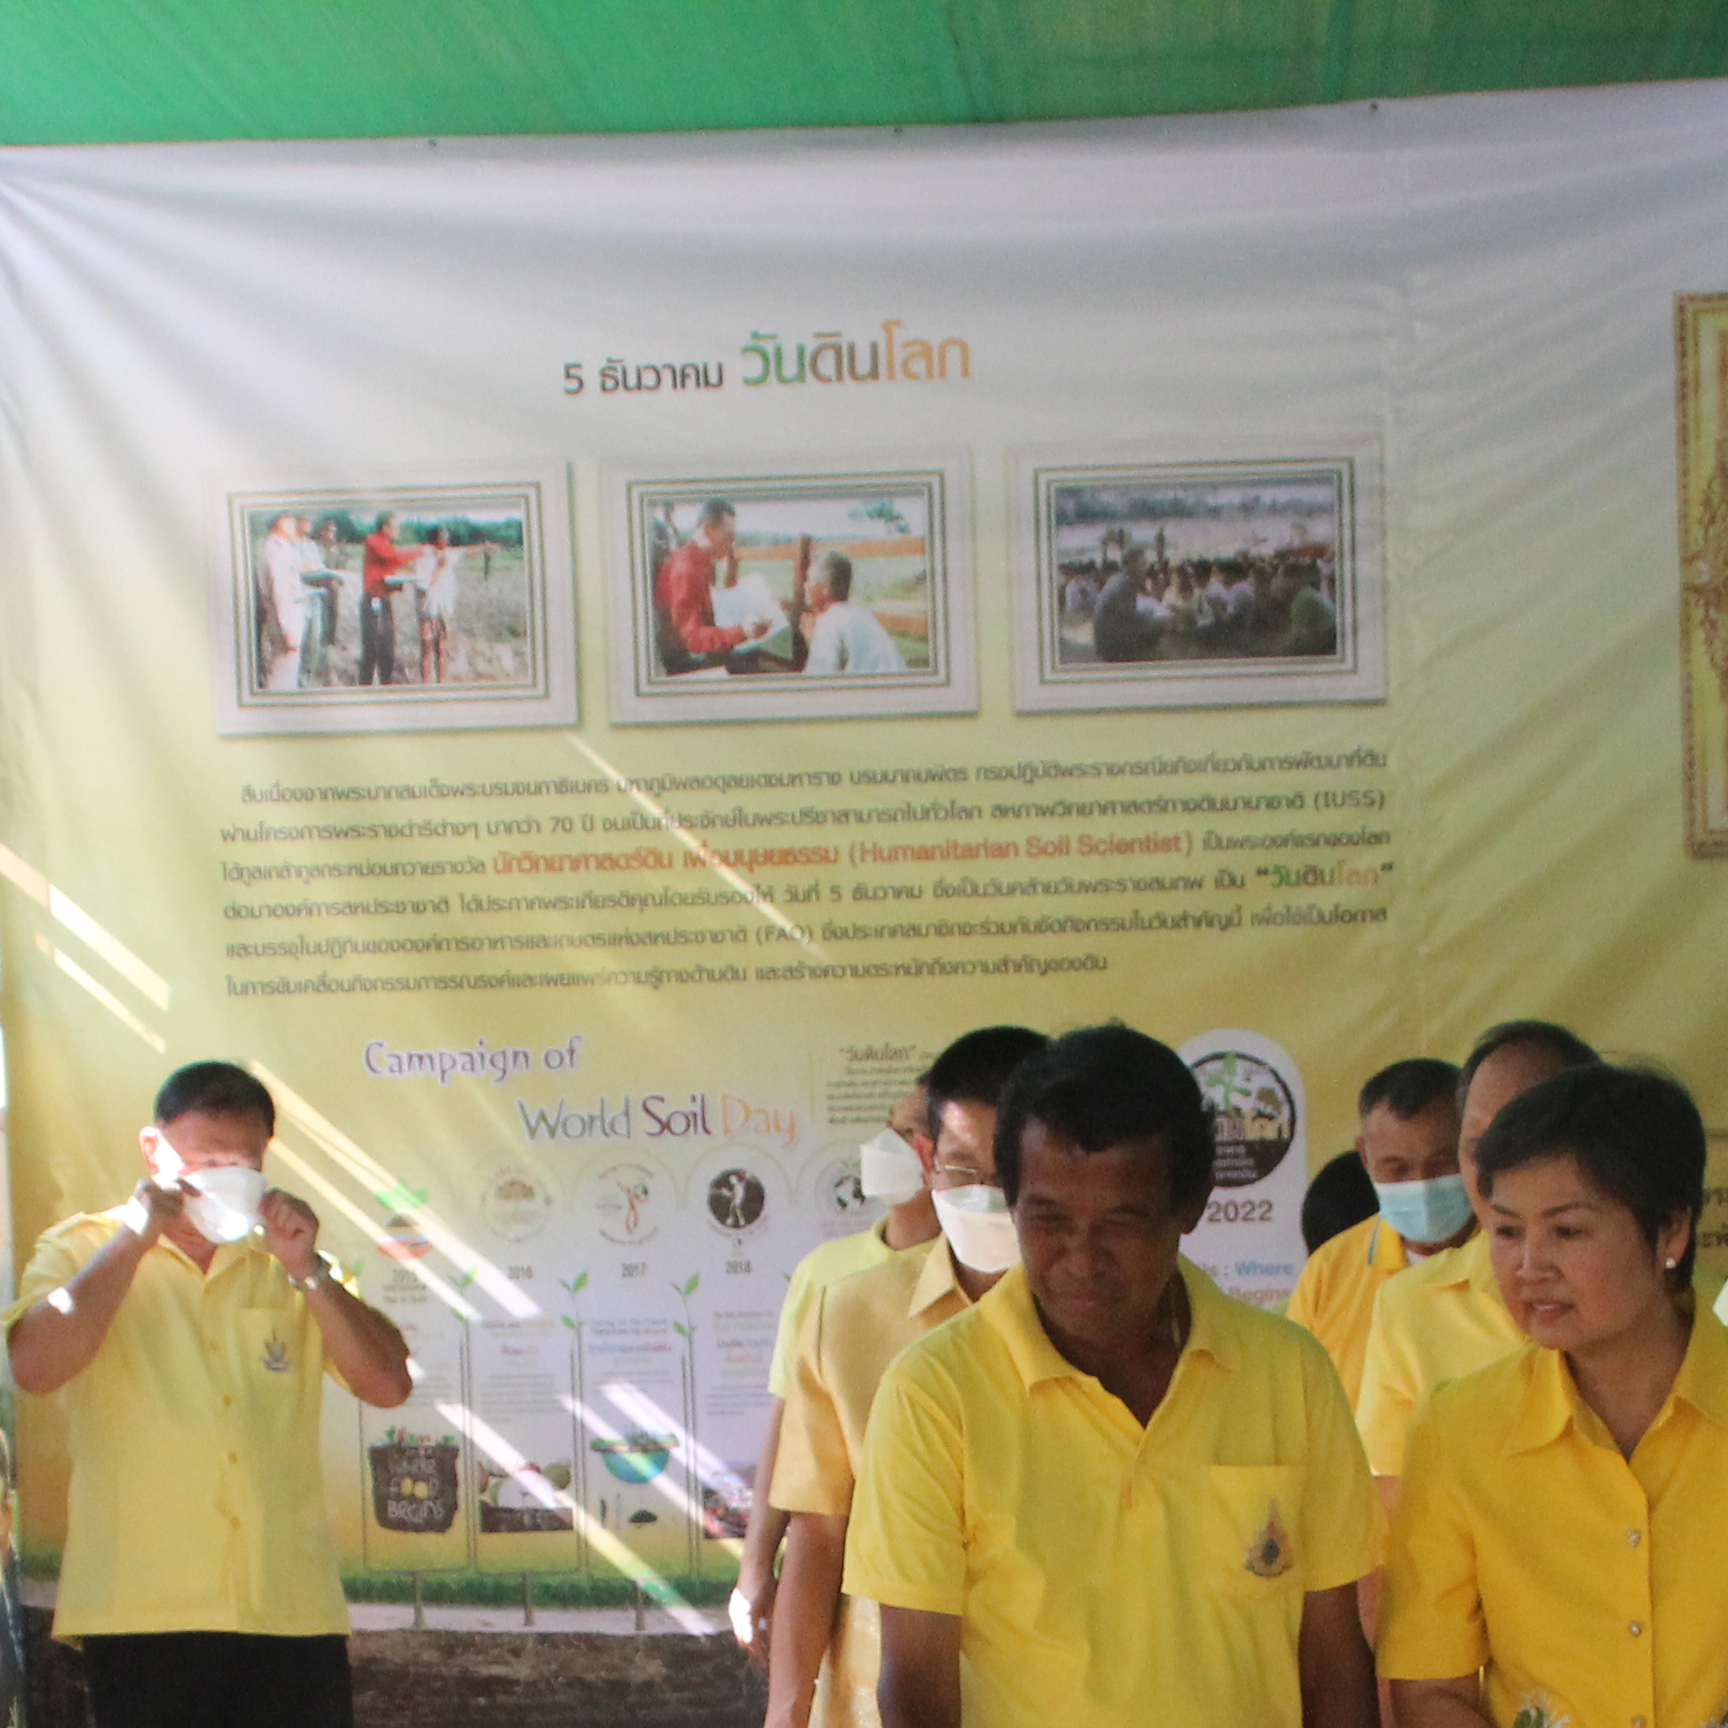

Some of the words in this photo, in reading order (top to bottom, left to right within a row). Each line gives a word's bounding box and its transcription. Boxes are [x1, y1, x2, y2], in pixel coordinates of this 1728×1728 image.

[563, 361, 584, 395] 5
[598, 357, 723, 394] ธันวาคม
[741, 319, 970, 385] วันดินโลก
[551, 816, 573, 833] 70
[583, 813, 594, 832] ปี
[1314, 789, 1384, 812] (IUSS)
[849, 837, 1018, 868] (Humanitarian
[1025, 834, 1071, 858] Soil
[1077, 830, 1193, 858] Scientist)
[831, 887, 840, 900] 5
[365, 1039, 529, 1086] Campaign
[544, 1036, 582, 1071] of
[517, 1094, 632, 1141] World
[642, 1094, 710, 1138] Soil
[722, 1095, 797, 1146] Day
[1208, 1199, 1273, 1223] 2022
[622, 1262, 646, 1278] 2017
[726, 1260, 752, 1275] 2018
